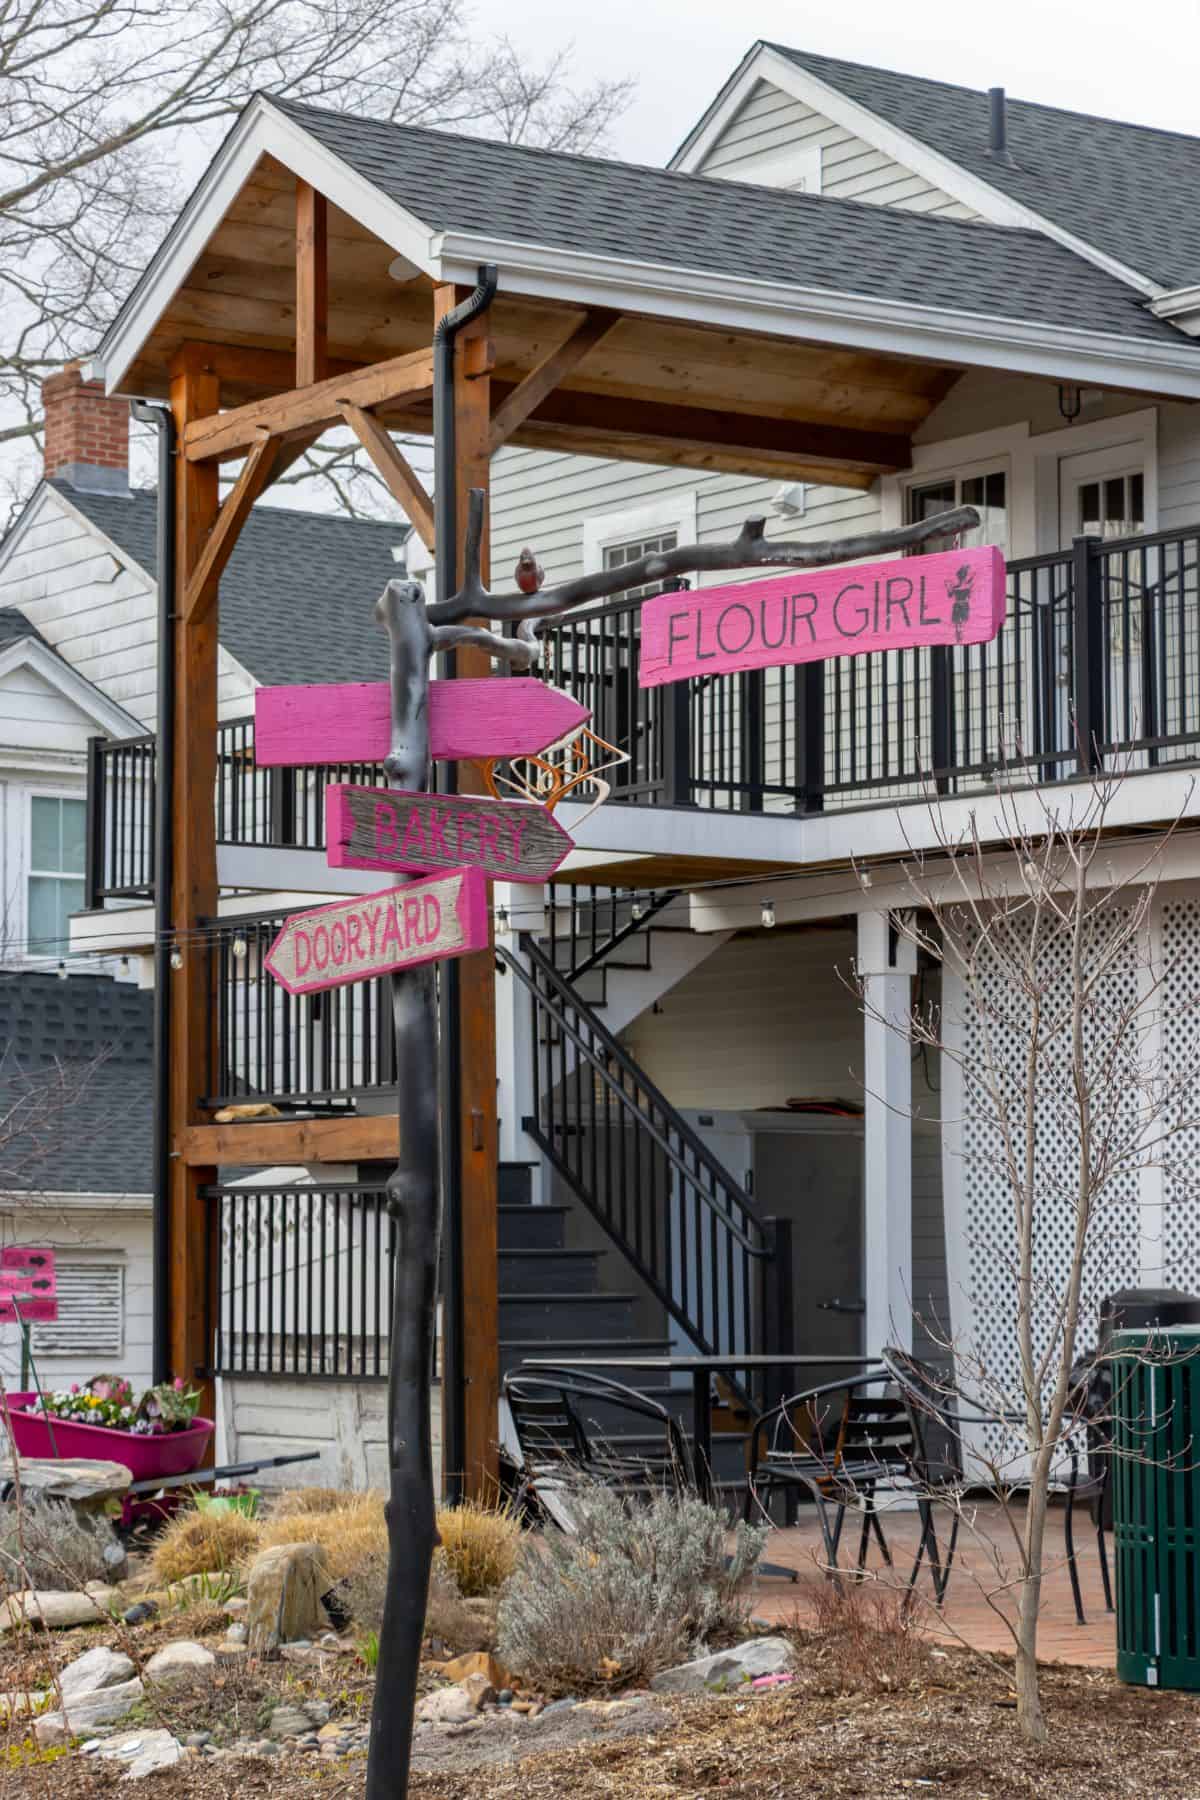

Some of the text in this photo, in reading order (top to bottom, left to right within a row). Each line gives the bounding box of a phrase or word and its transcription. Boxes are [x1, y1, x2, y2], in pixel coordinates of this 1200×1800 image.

[667, 575, 942, 666] FLOUR GIRL
[374, 802, 528, 865] BAKERY
[294, 893, 441, 978] DOORYARD
